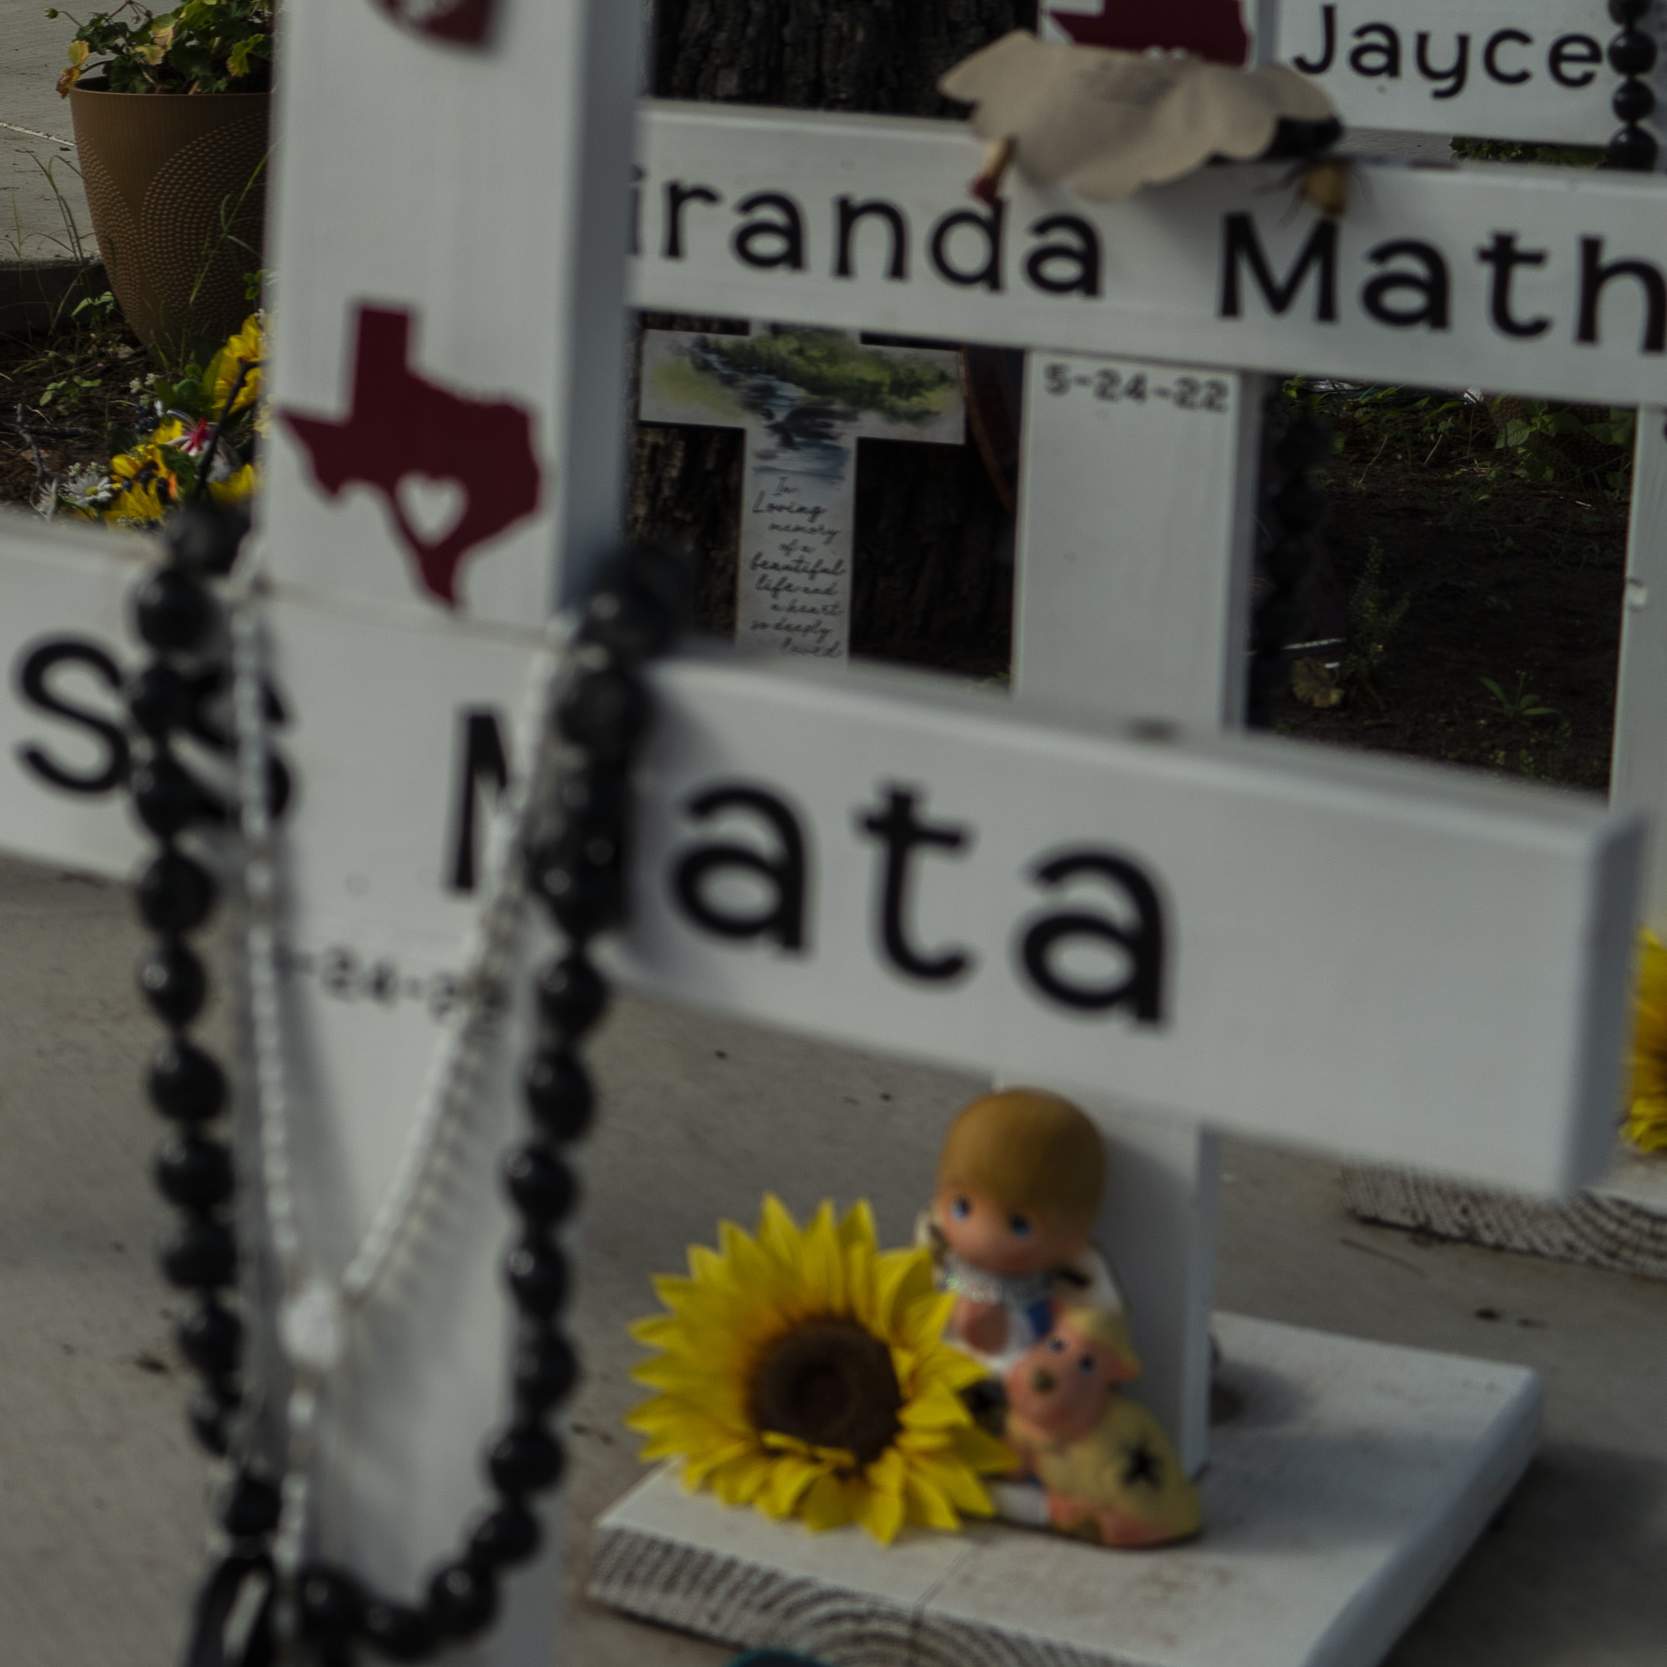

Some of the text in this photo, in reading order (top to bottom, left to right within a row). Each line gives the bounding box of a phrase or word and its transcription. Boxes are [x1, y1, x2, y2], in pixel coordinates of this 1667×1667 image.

[1293, 4, 1604, 98] Jayce
[1219, 210, 1667, 354] Math
[1044, 363, 1229, 413] 5-24-22
[752, 490, 827, 523] Loving
[768, 522, 839, 546] memory
[749, 551, 846, 581] beautiful
[755, 574, 839, 599] life and
[773, 617, 833, 643] deeply
